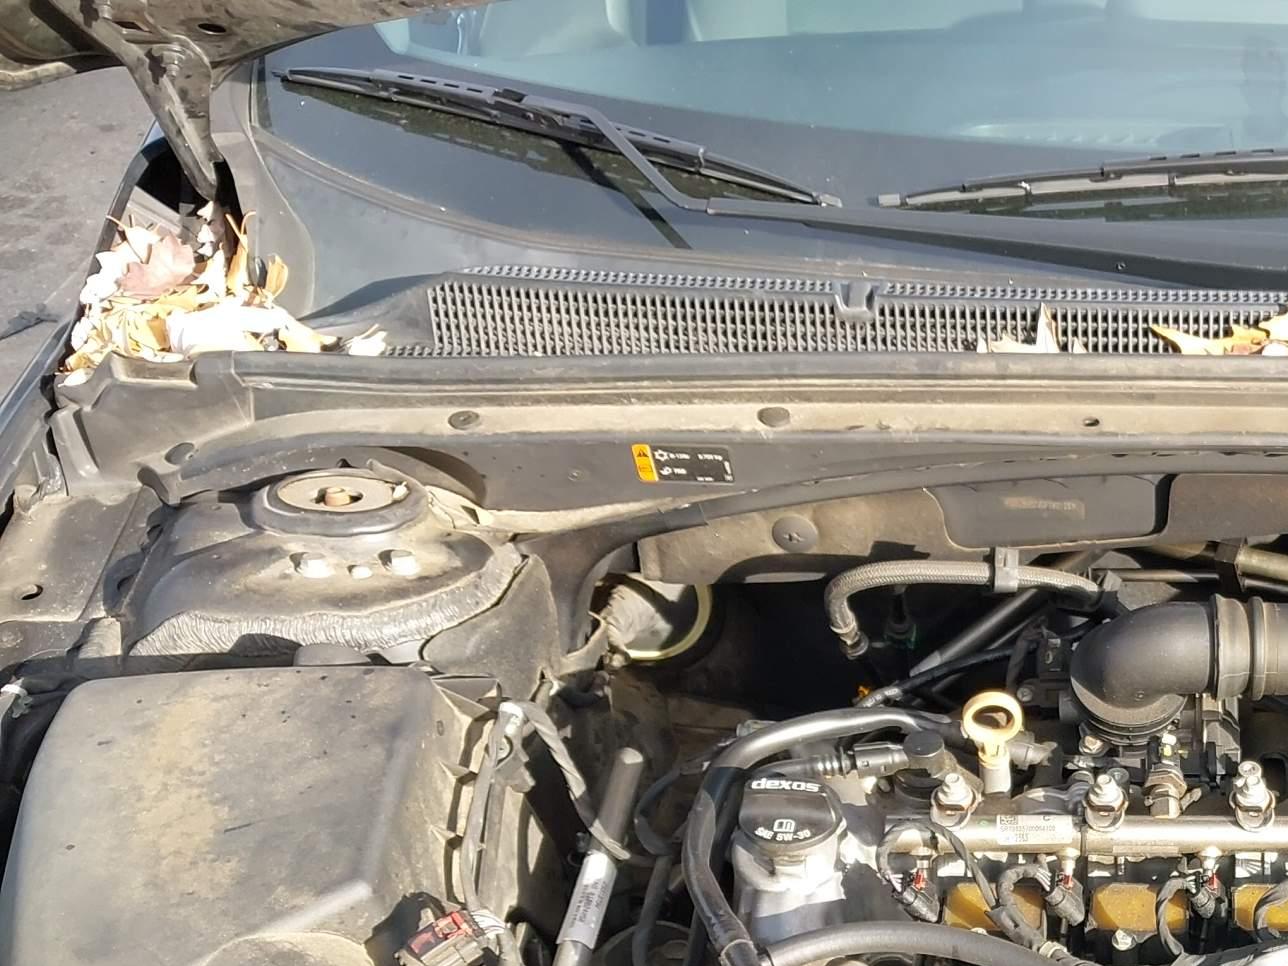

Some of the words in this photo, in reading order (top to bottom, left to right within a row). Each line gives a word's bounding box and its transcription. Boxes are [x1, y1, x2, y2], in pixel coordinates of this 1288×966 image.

[751, 778, 822, 792] dexos
[754, 827, 775, 840] SAE
[775, 829, 811, 841] 5W-30
